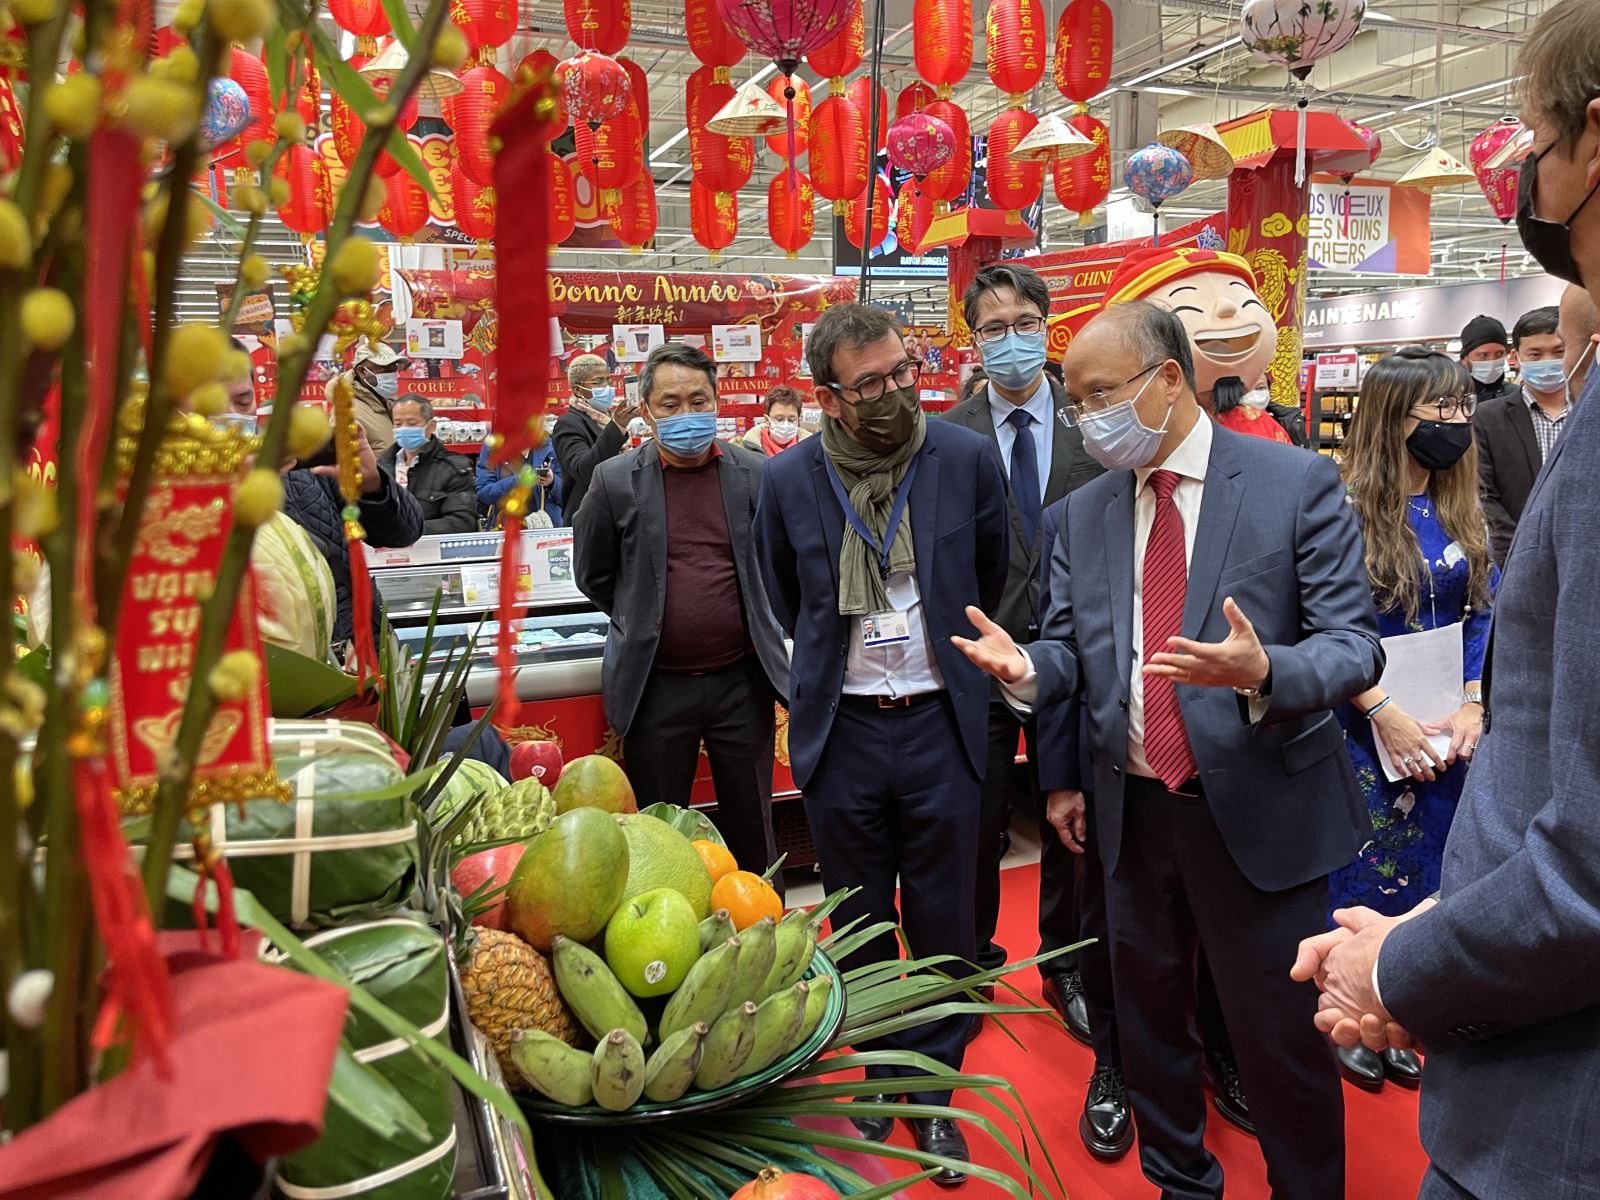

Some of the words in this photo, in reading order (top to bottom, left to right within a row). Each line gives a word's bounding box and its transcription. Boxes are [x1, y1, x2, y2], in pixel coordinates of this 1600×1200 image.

[1312, 241, 1366, 265] CHERS
[548, 276, 642, 303] Bonne
[654, 276, 742, 303] Année
[407, 380, 456, 393] CORÉE
[718, 379, 772, 391] HAÏLANDE
